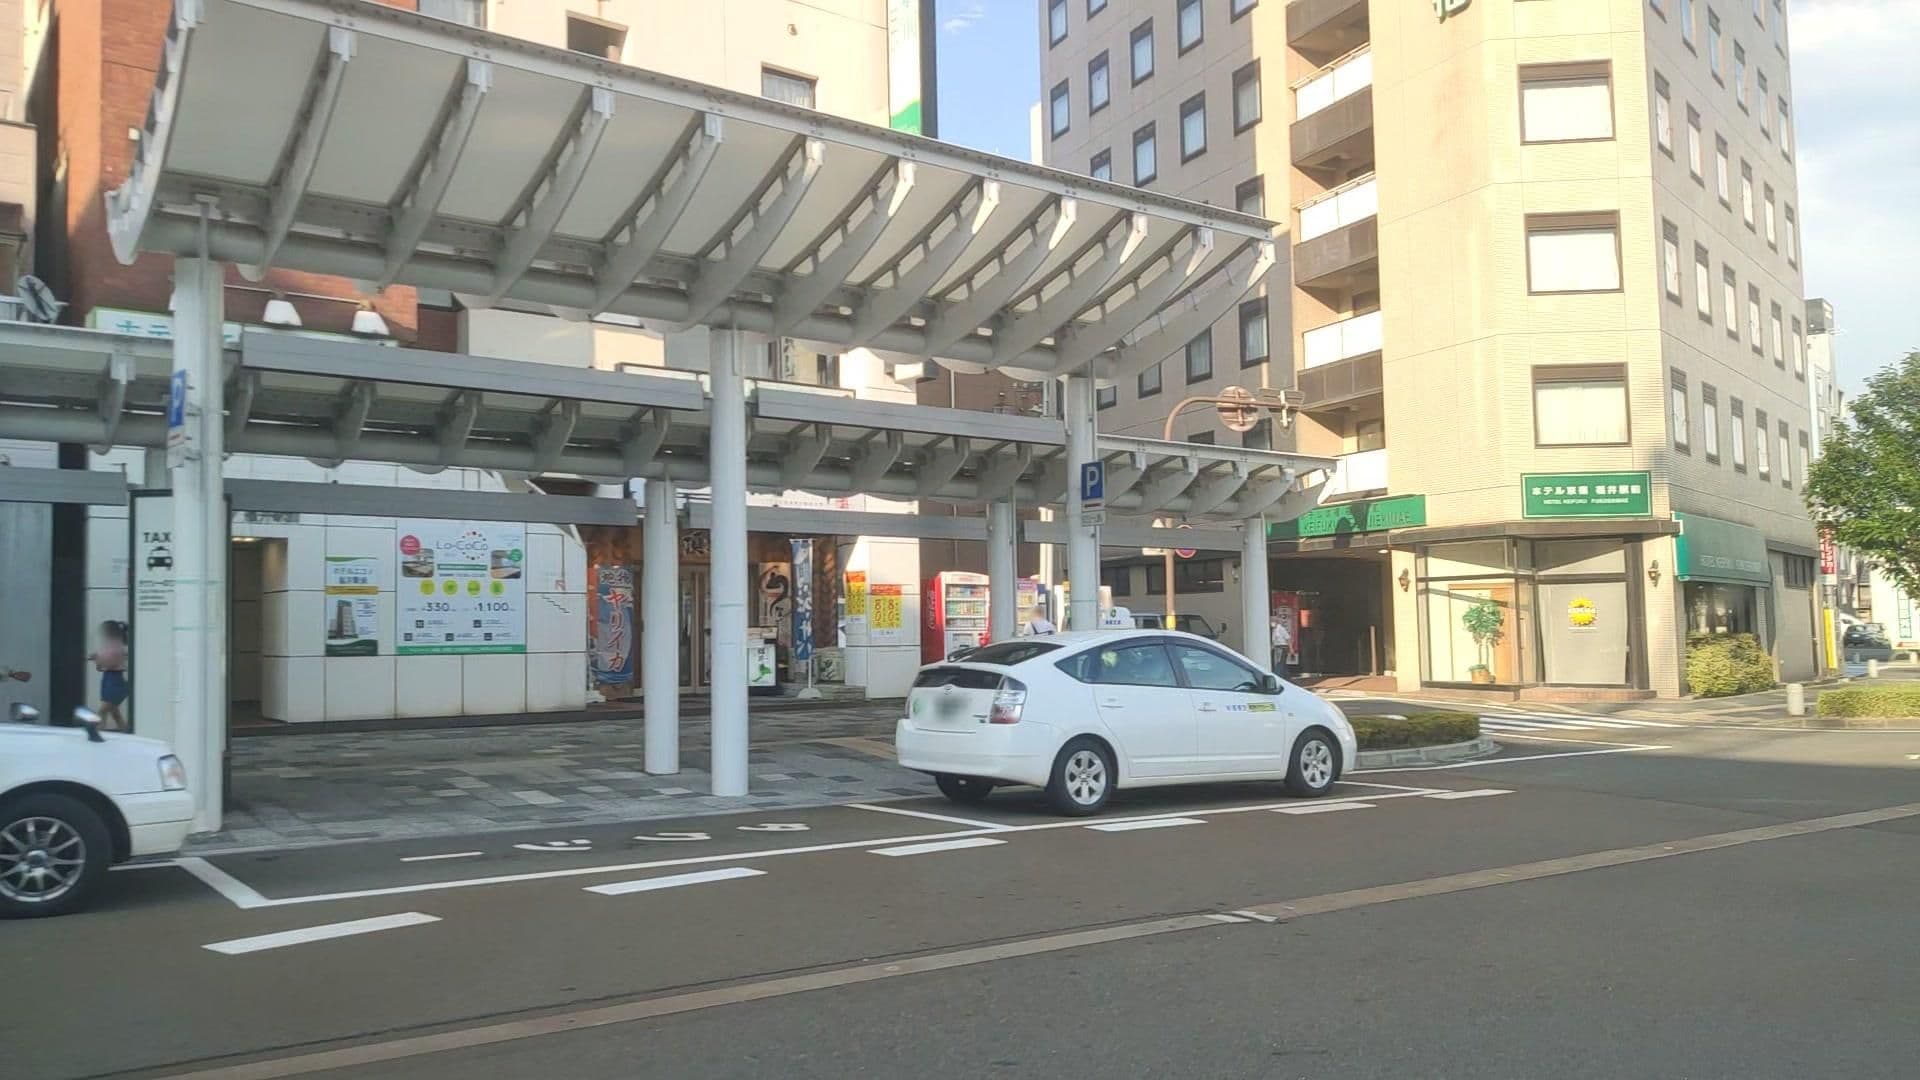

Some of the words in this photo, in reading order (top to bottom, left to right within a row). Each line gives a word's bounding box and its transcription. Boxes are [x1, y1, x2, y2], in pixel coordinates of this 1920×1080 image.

[1087, 466, 1099, 496] P
[607, 589, 625, 672] ヤリイカ
